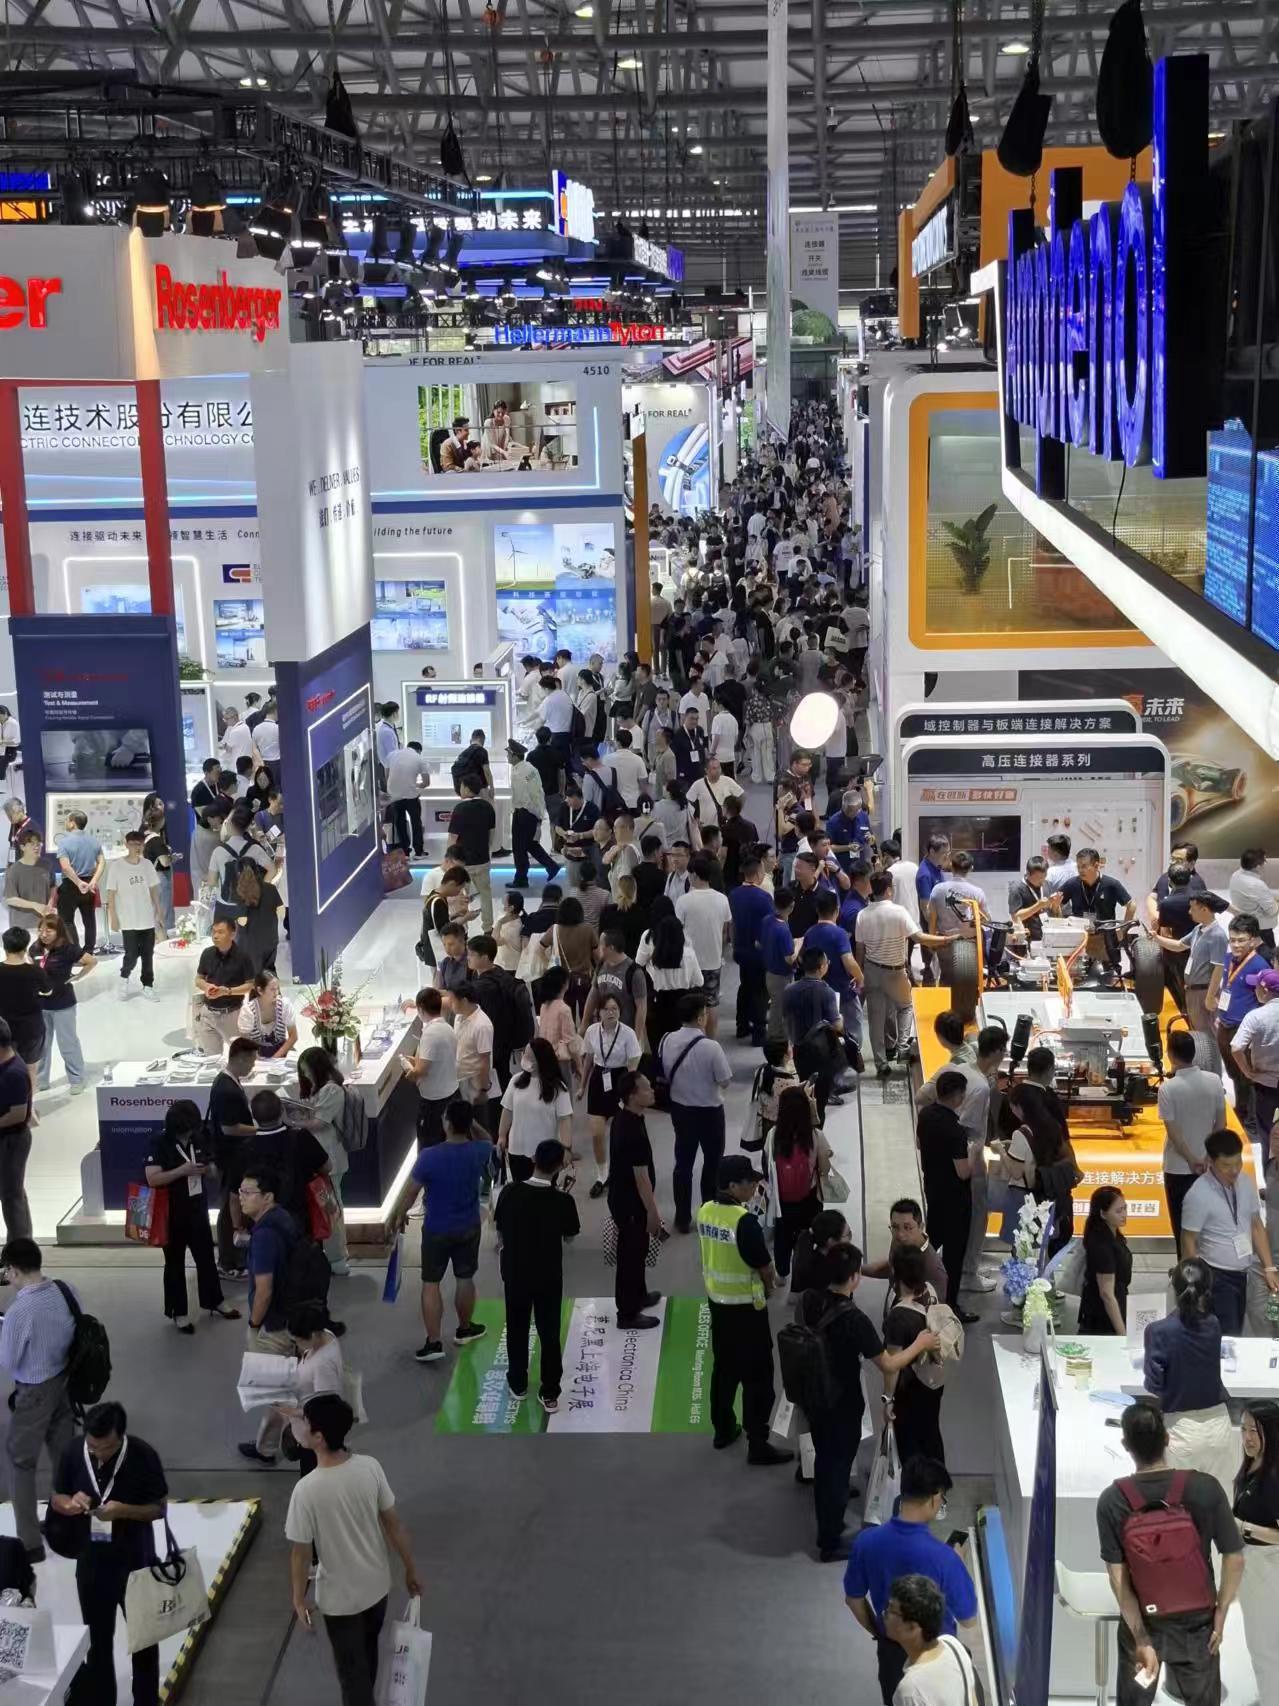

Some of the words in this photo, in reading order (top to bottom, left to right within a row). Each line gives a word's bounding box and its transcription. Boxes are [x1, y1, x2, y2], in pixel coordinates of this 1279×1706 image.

[154, 263, 281, 342] Rosenberger
[494, 321, 665, 345] HellermannTyton
[583, 366, 609, 375] 4510
[405, 527, 420, 536] the
[423, 526, 453, 536] future
[1144, 698, 1184, 715] 未来
[924, 717, 1112, 732] 域控制器与板端连接解决方案
[981, 754, 1092, 767] 高压连接器系列
[567, 1315, 610, 1412] 慕尼黑上海电子展
[618, 1329, 640, 1382] electronica
[614, 1383, 635, 1412] China
